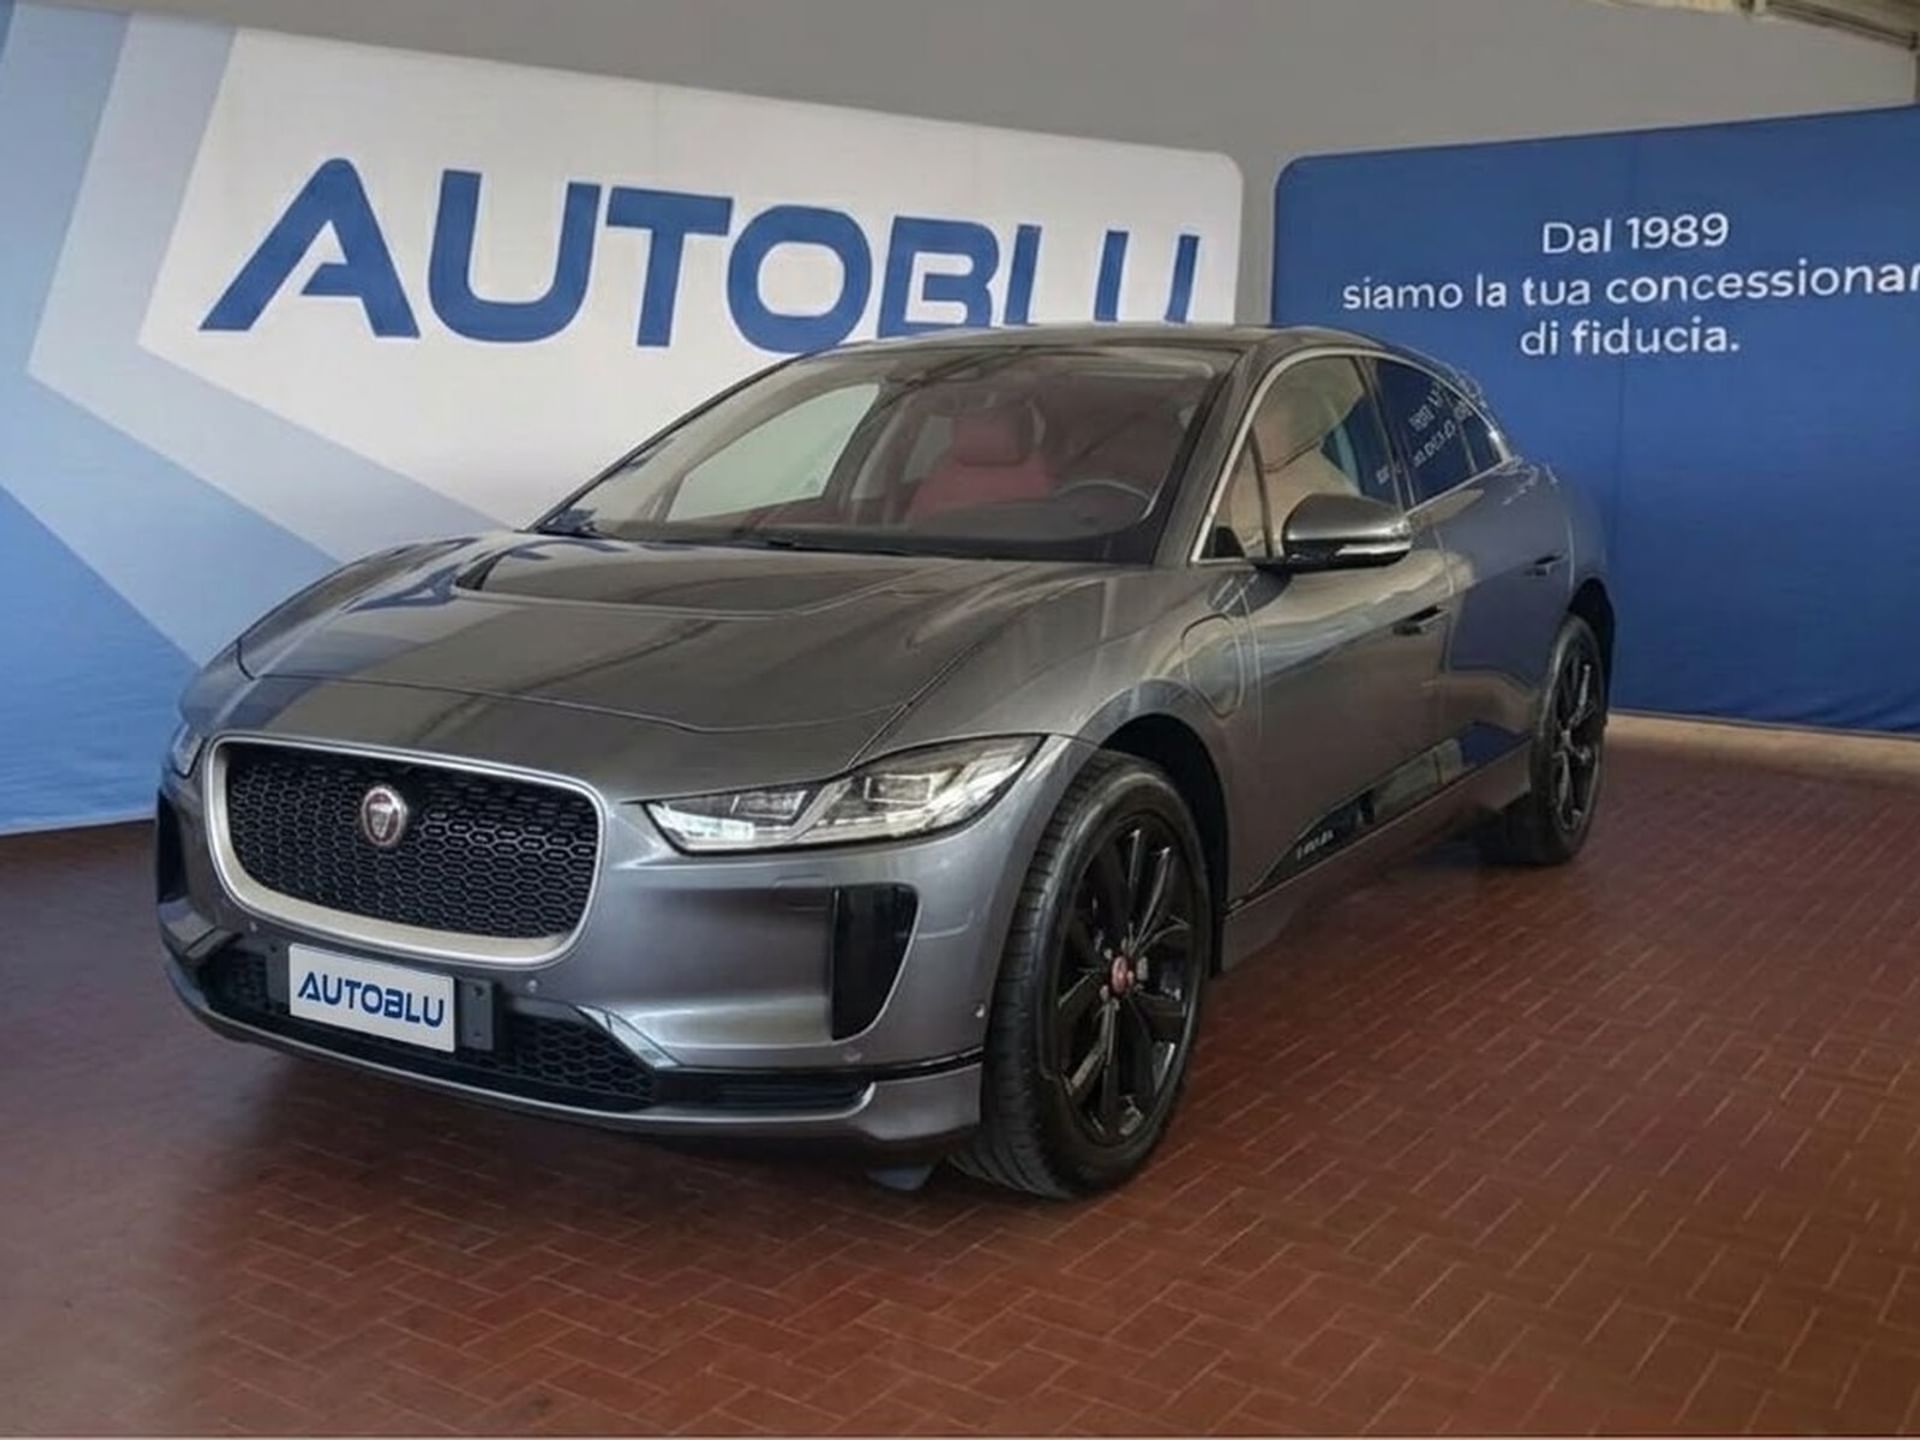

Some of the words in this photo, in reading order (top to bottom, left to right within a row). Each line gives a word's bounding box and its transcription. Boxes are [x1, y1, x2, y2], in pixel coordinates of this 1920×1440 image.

[1542, 218, 1613, 254] Dal
[1626, 213, 1730, 249] 1989
[1342, 276, 1463, 310] siamo
[1475, 274, 1508, 308] la
[1522, 278, 1591, 306] tua
[1605, 258, 1920, 305] concessionar
[1520, 320, 1559, 356] di
[1571, 316, 1740, 354] fiducia.
[297, 970, 446, 1029] AUTOBLU
